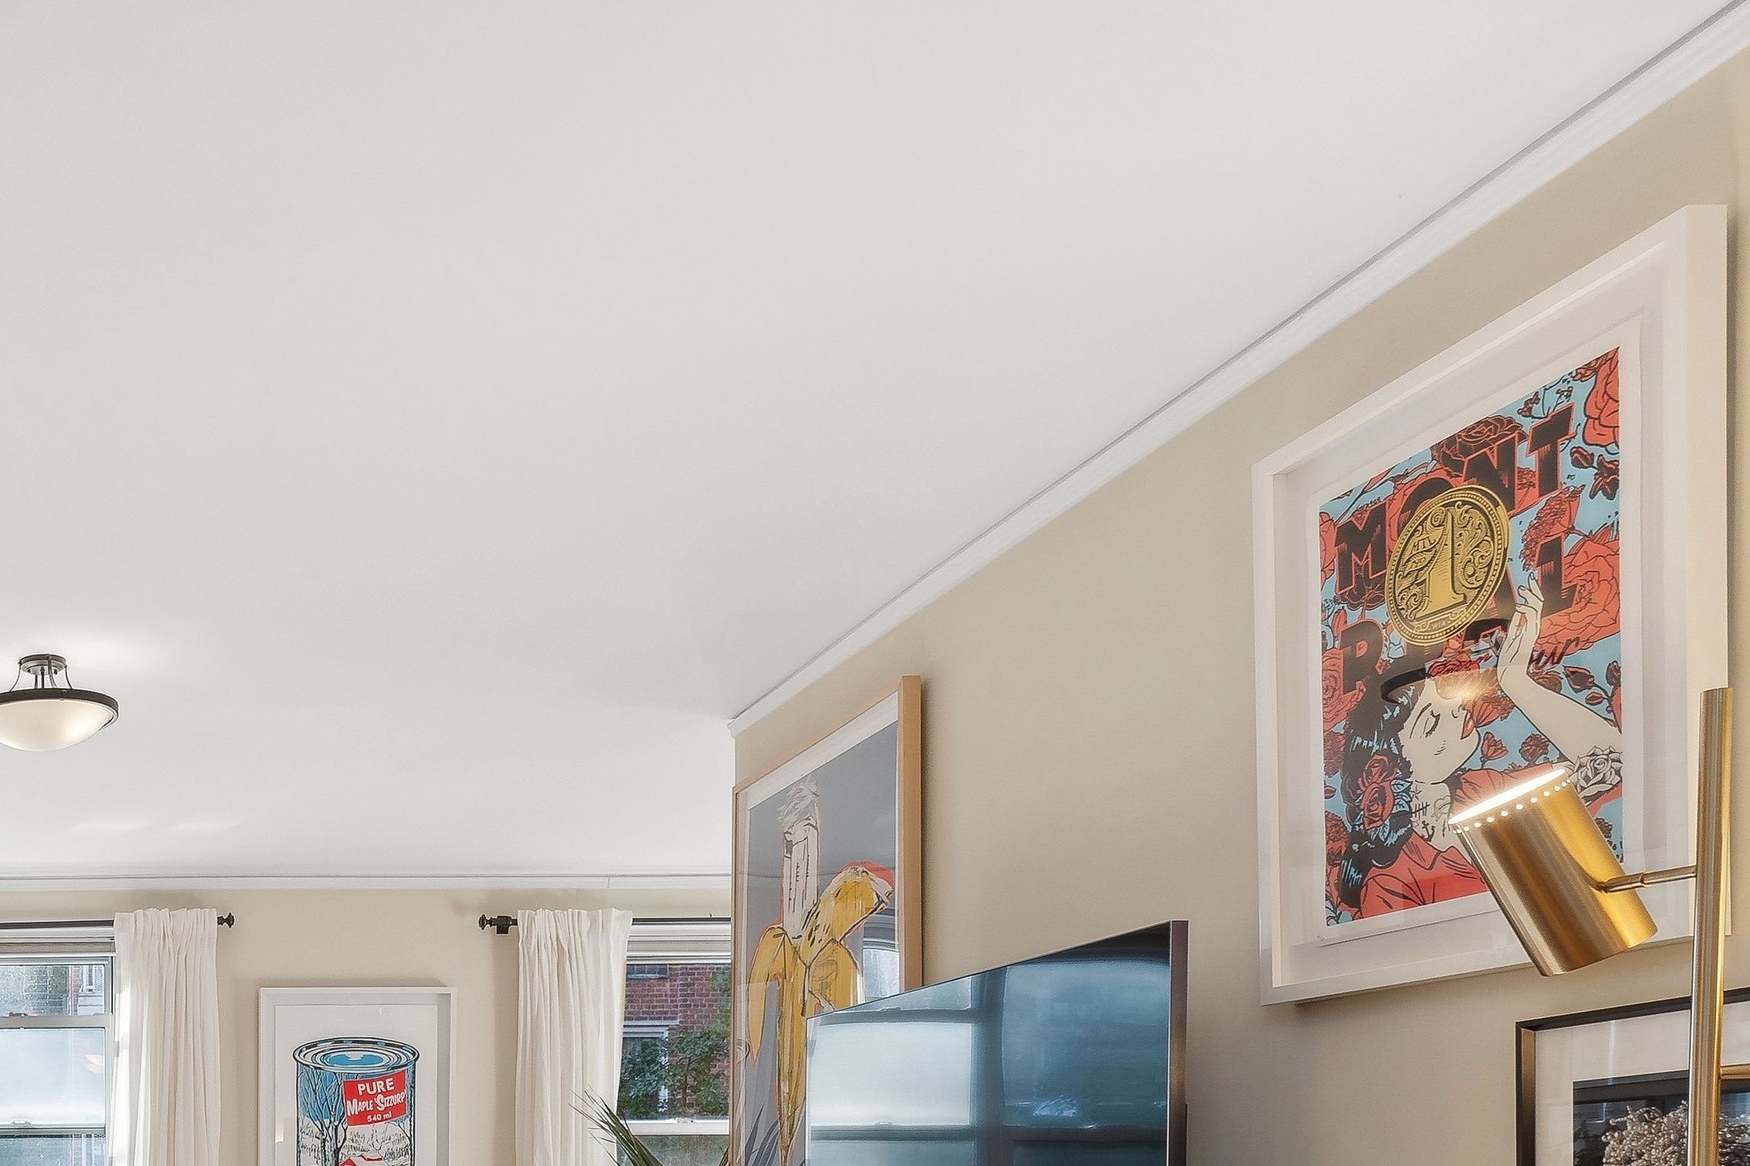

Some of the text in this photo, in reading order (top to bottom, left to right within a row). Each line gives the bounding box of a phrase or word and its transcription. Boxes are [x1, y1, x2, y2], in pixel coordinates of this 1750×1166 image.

[357, 1077, 395, 1096] PURE
[347, 1097, 374, 1117] MAPLE
[367, 1110, 392, 1123] 540 ml
